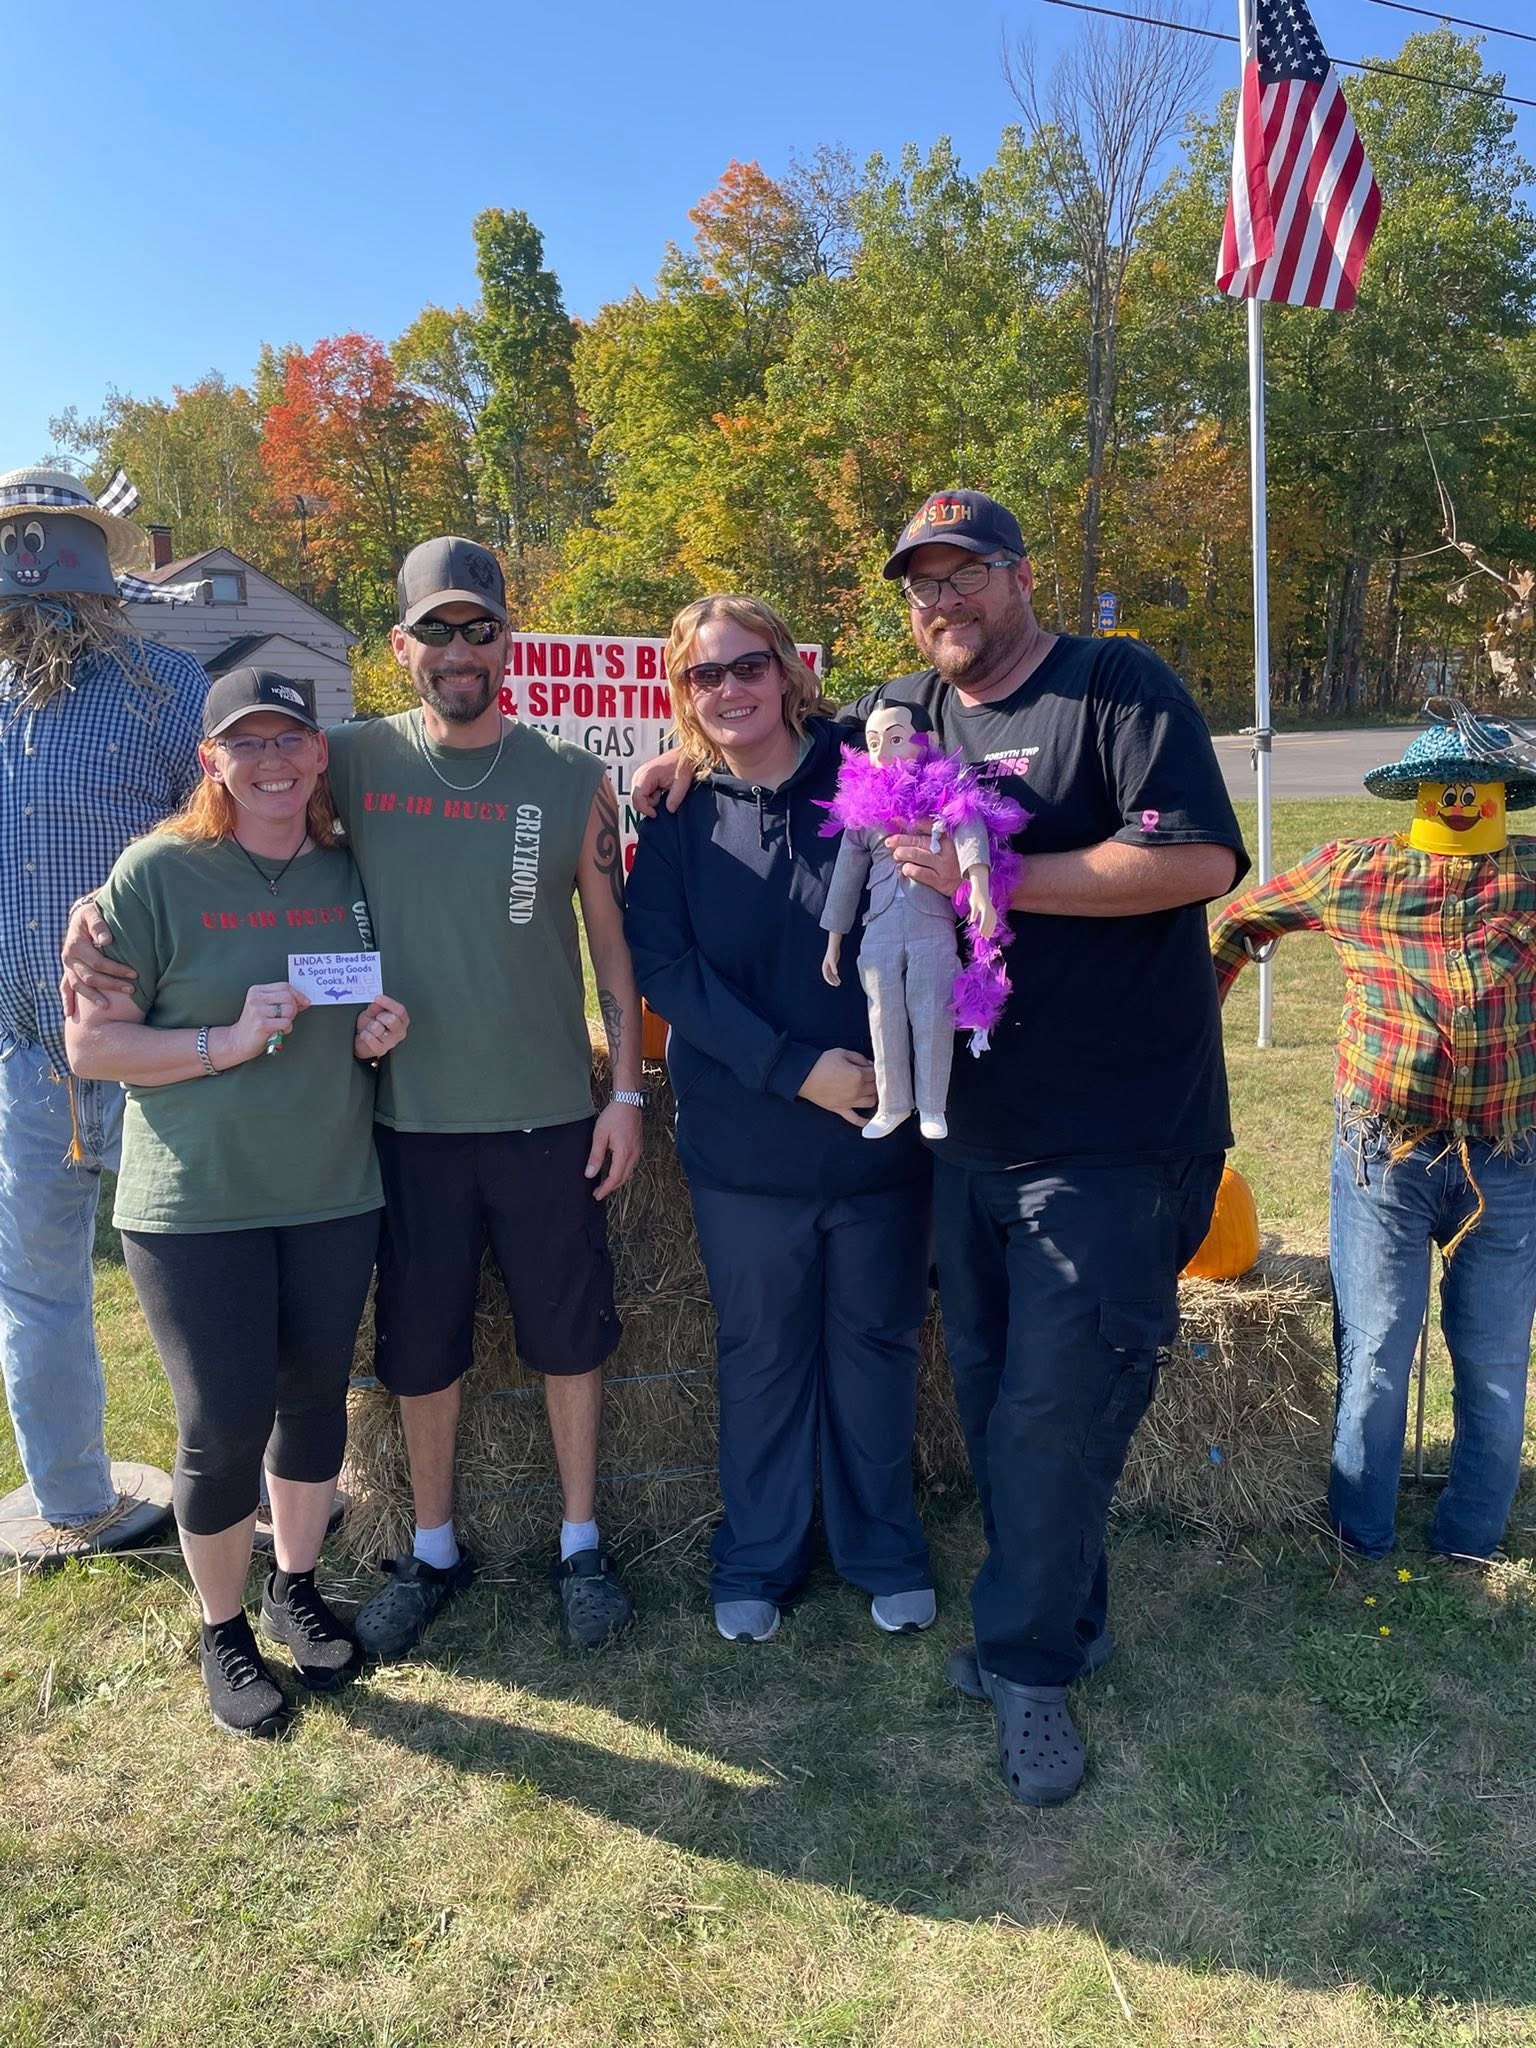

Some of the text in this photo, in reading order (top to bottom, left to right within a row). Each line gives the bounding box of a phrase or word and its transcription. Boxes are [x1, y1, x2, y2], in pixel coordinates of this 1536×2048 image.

[504, 642, 625, 680] INDA'S
[497, 682, 673, 719] & SPORTIN
[584, 726, 635, 757] GAS
[984, 746, 1040, 762] FORSYTH TWP
[986, 757, 1030, 778] EMS
[443, 799, 510, 821] HUEY
[508, 803, 543, 925] GREYHOUND
[293, 953, 376, 966] LINDA'S Bread Box
[297, 965, 372, 976] & Sporting Goods
[346, 975, 358, 984] MI
